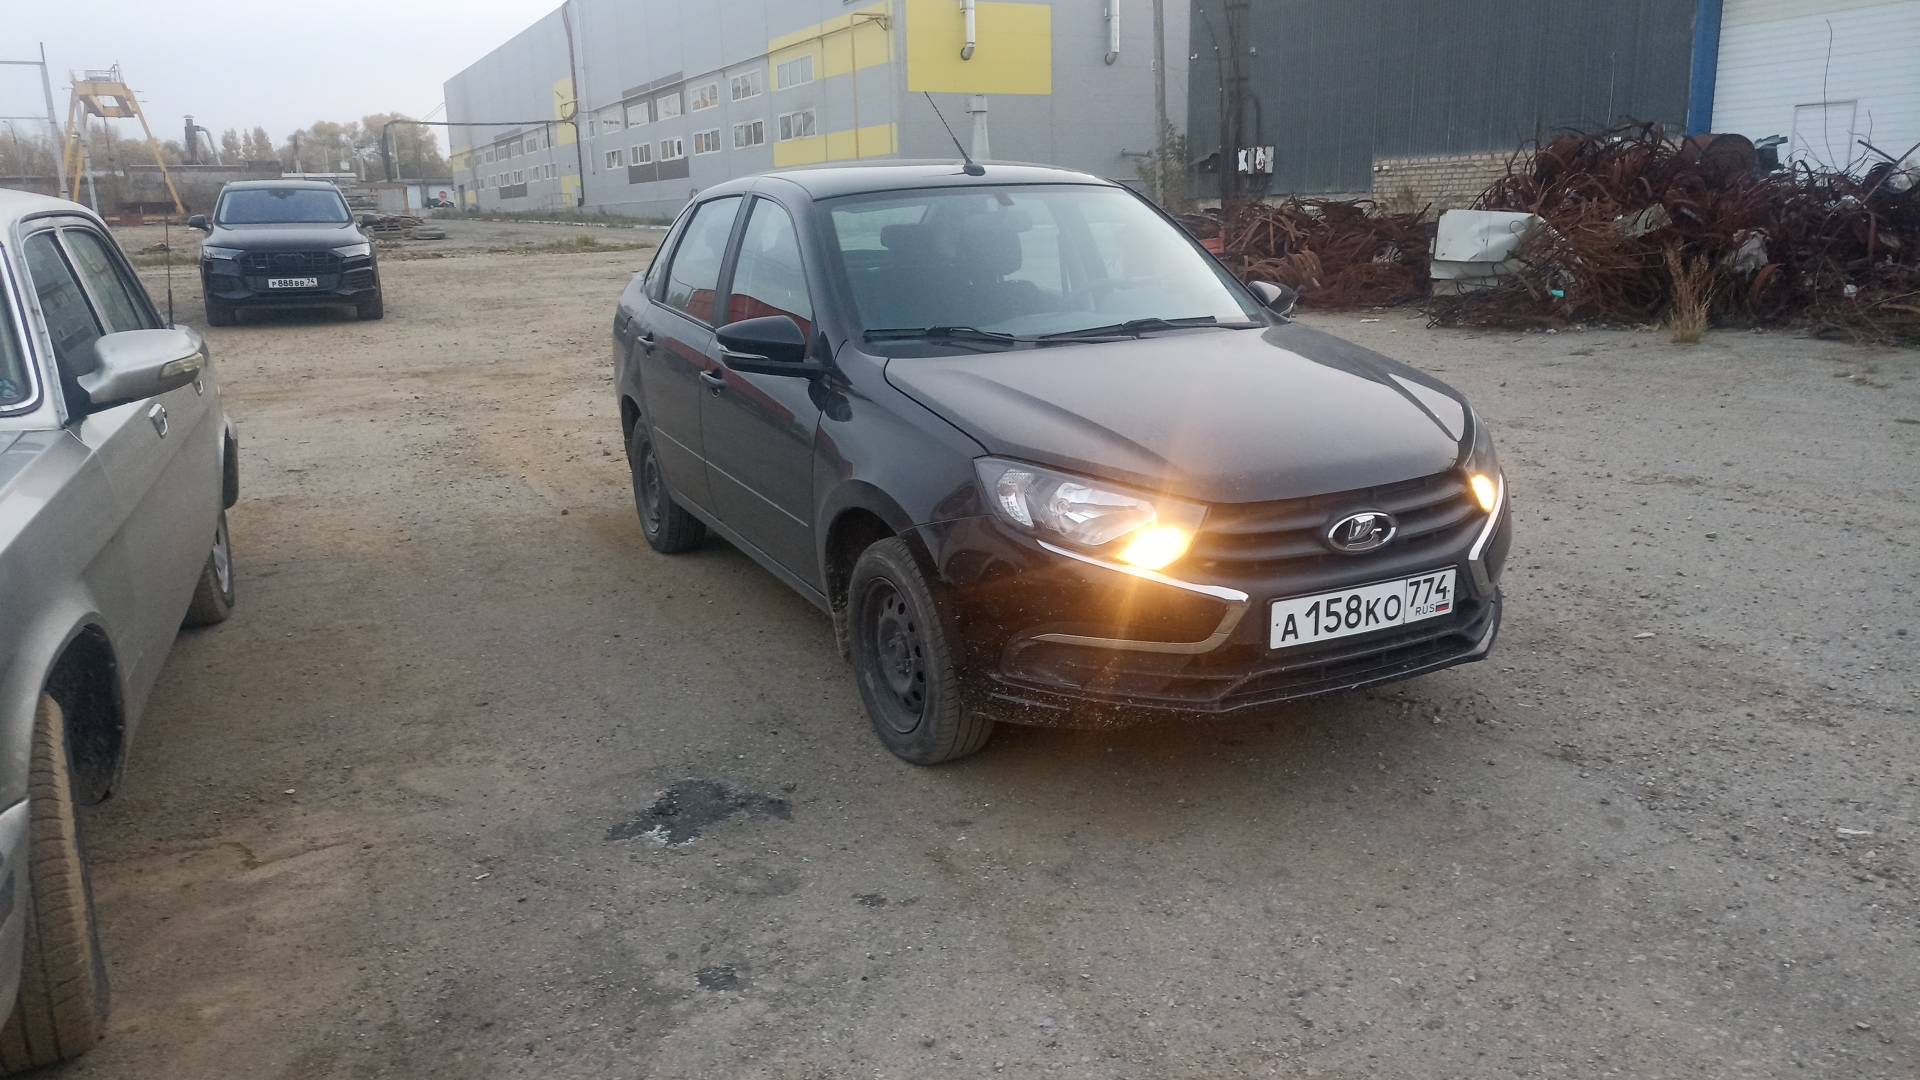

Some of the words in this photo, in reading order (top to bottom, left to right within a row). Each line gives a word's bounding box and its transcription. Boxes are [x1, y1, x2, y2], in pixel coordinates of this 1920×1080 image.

[1281, 594, 1401, 642] А158КО
[1409, 574, 1448, 608] 774
[1415, 604, 1435, 616] RUS
